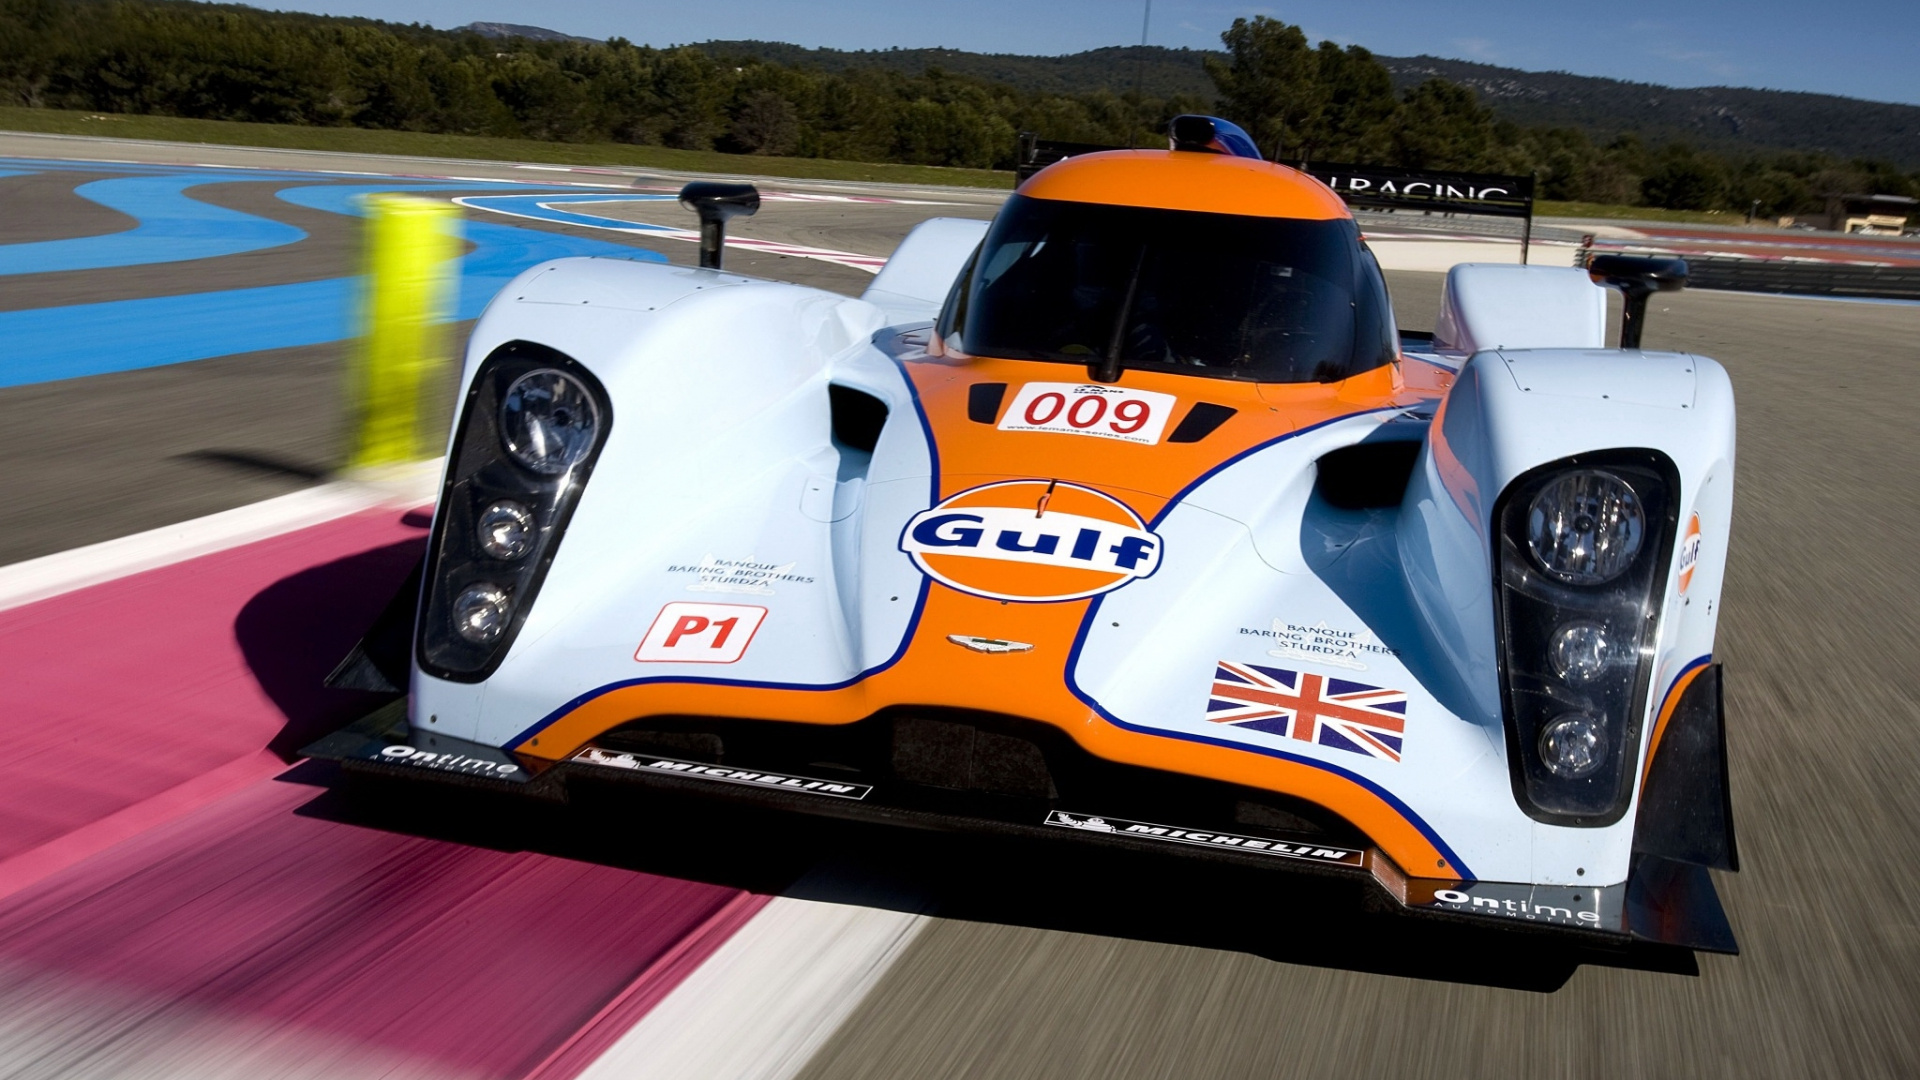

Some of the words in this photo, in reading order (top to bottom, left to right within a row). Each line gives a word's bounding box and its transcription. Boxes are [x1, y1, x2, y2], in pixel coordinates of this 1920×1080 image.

[1024, 392, 1151, 434] 009
[1007, 425, 1150, 443] www.lemans-series.com
[912, 513, 1155, 570] Gulf
[667, 565, 725, 575] BARING
[734, 569, 815, 584] BROTHERS
[700, 575, 769, 587] STURDZA
[663, 615, 739, 648] P1
[1239, 627, 1302, 641] BARING
[1314, 636, 1401, 657] BROTHERS
[1287, 624, 1355, 638] BANQUE
[1279, 640, 1357, 659] STURDZA
[381, 745, 519, 774] Ontime
[649, 760, 855, 793] MICHELIN
[1125, 824, 1347, 860] MICHELIN
[1434, 889, 1600, 922] Ontime
